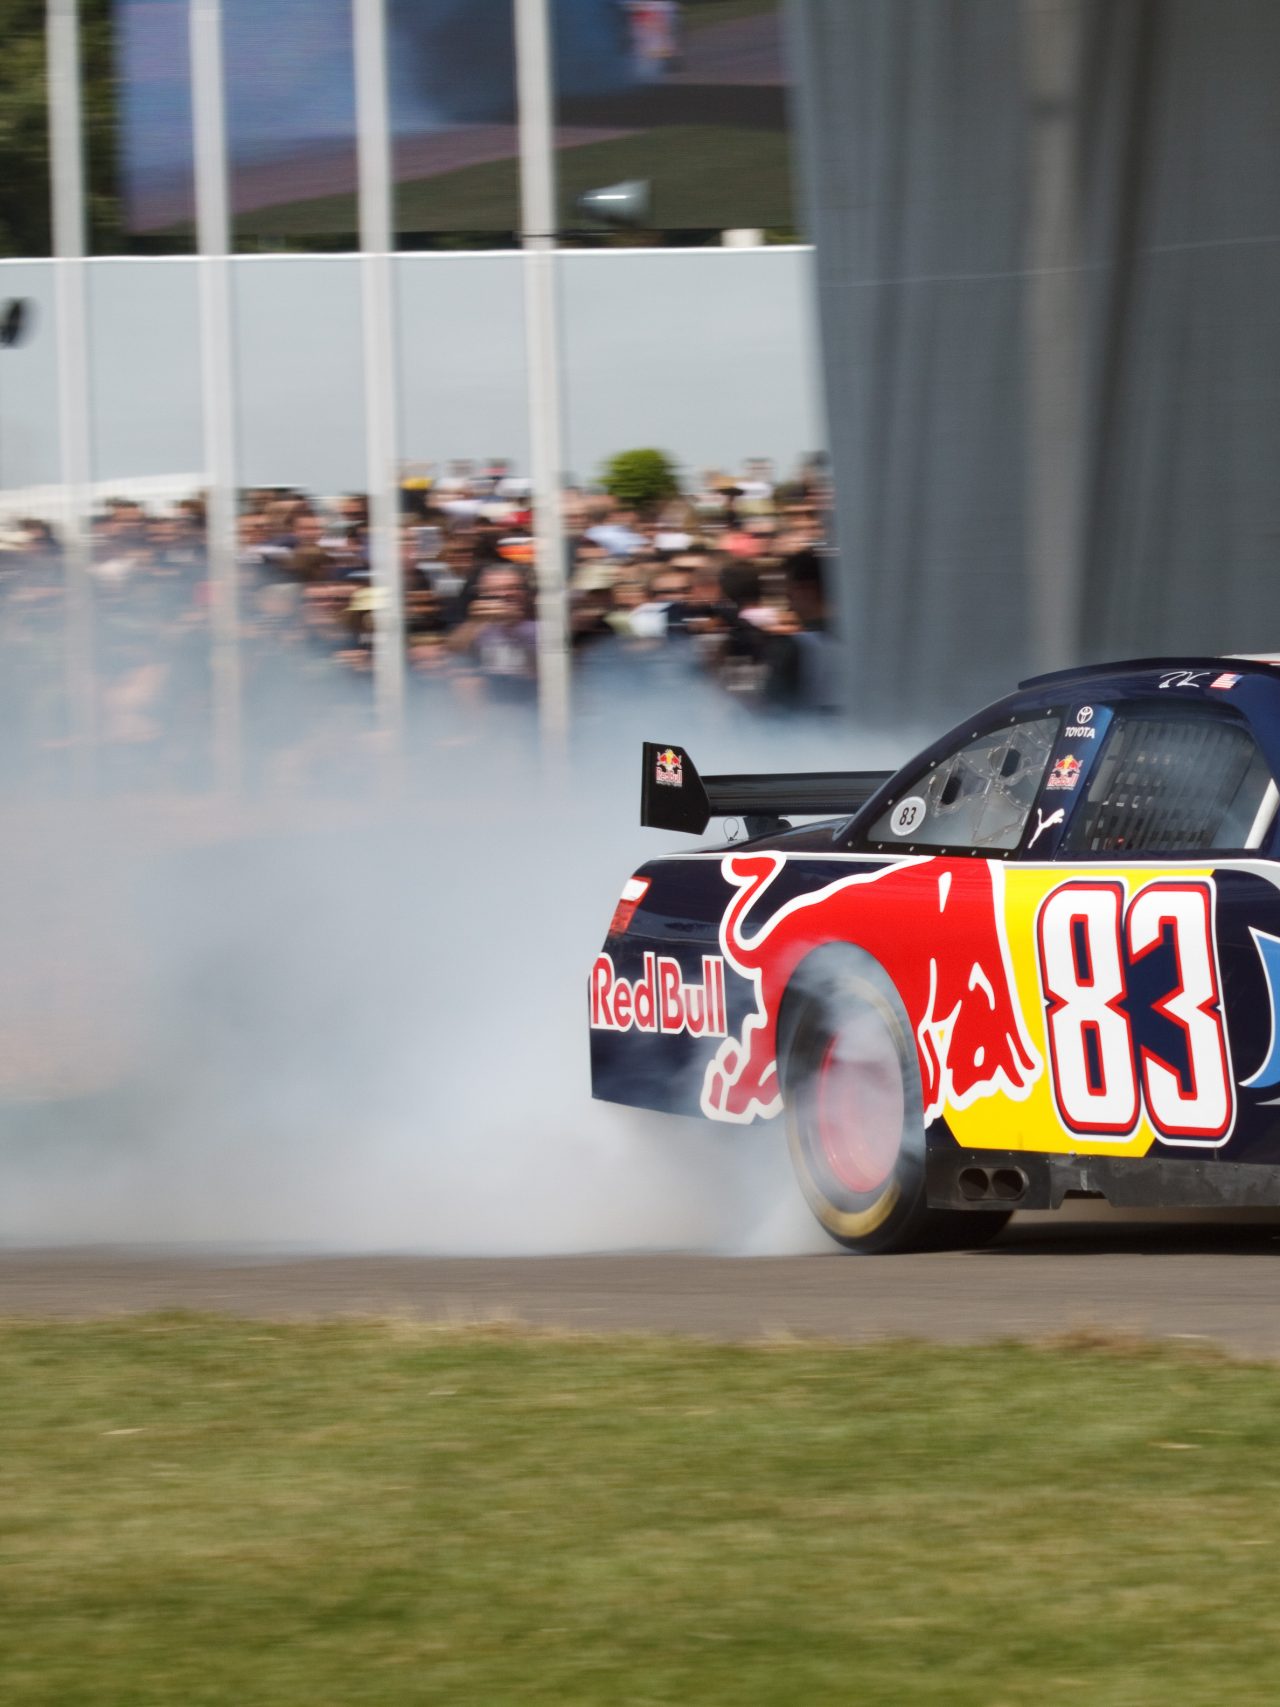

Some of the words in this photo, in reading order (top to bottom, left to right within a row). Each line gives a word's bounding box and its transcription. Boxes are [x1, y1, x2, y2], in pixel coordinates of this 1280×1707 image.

[1065, 727, 1095, 739] TOYOTA
[899, 806, 917, 826] 83
[591, 954, 657, 1031] Red
[658, 956, 727, 1036] Bull
[1037, 878, 1236, 1144] 83
